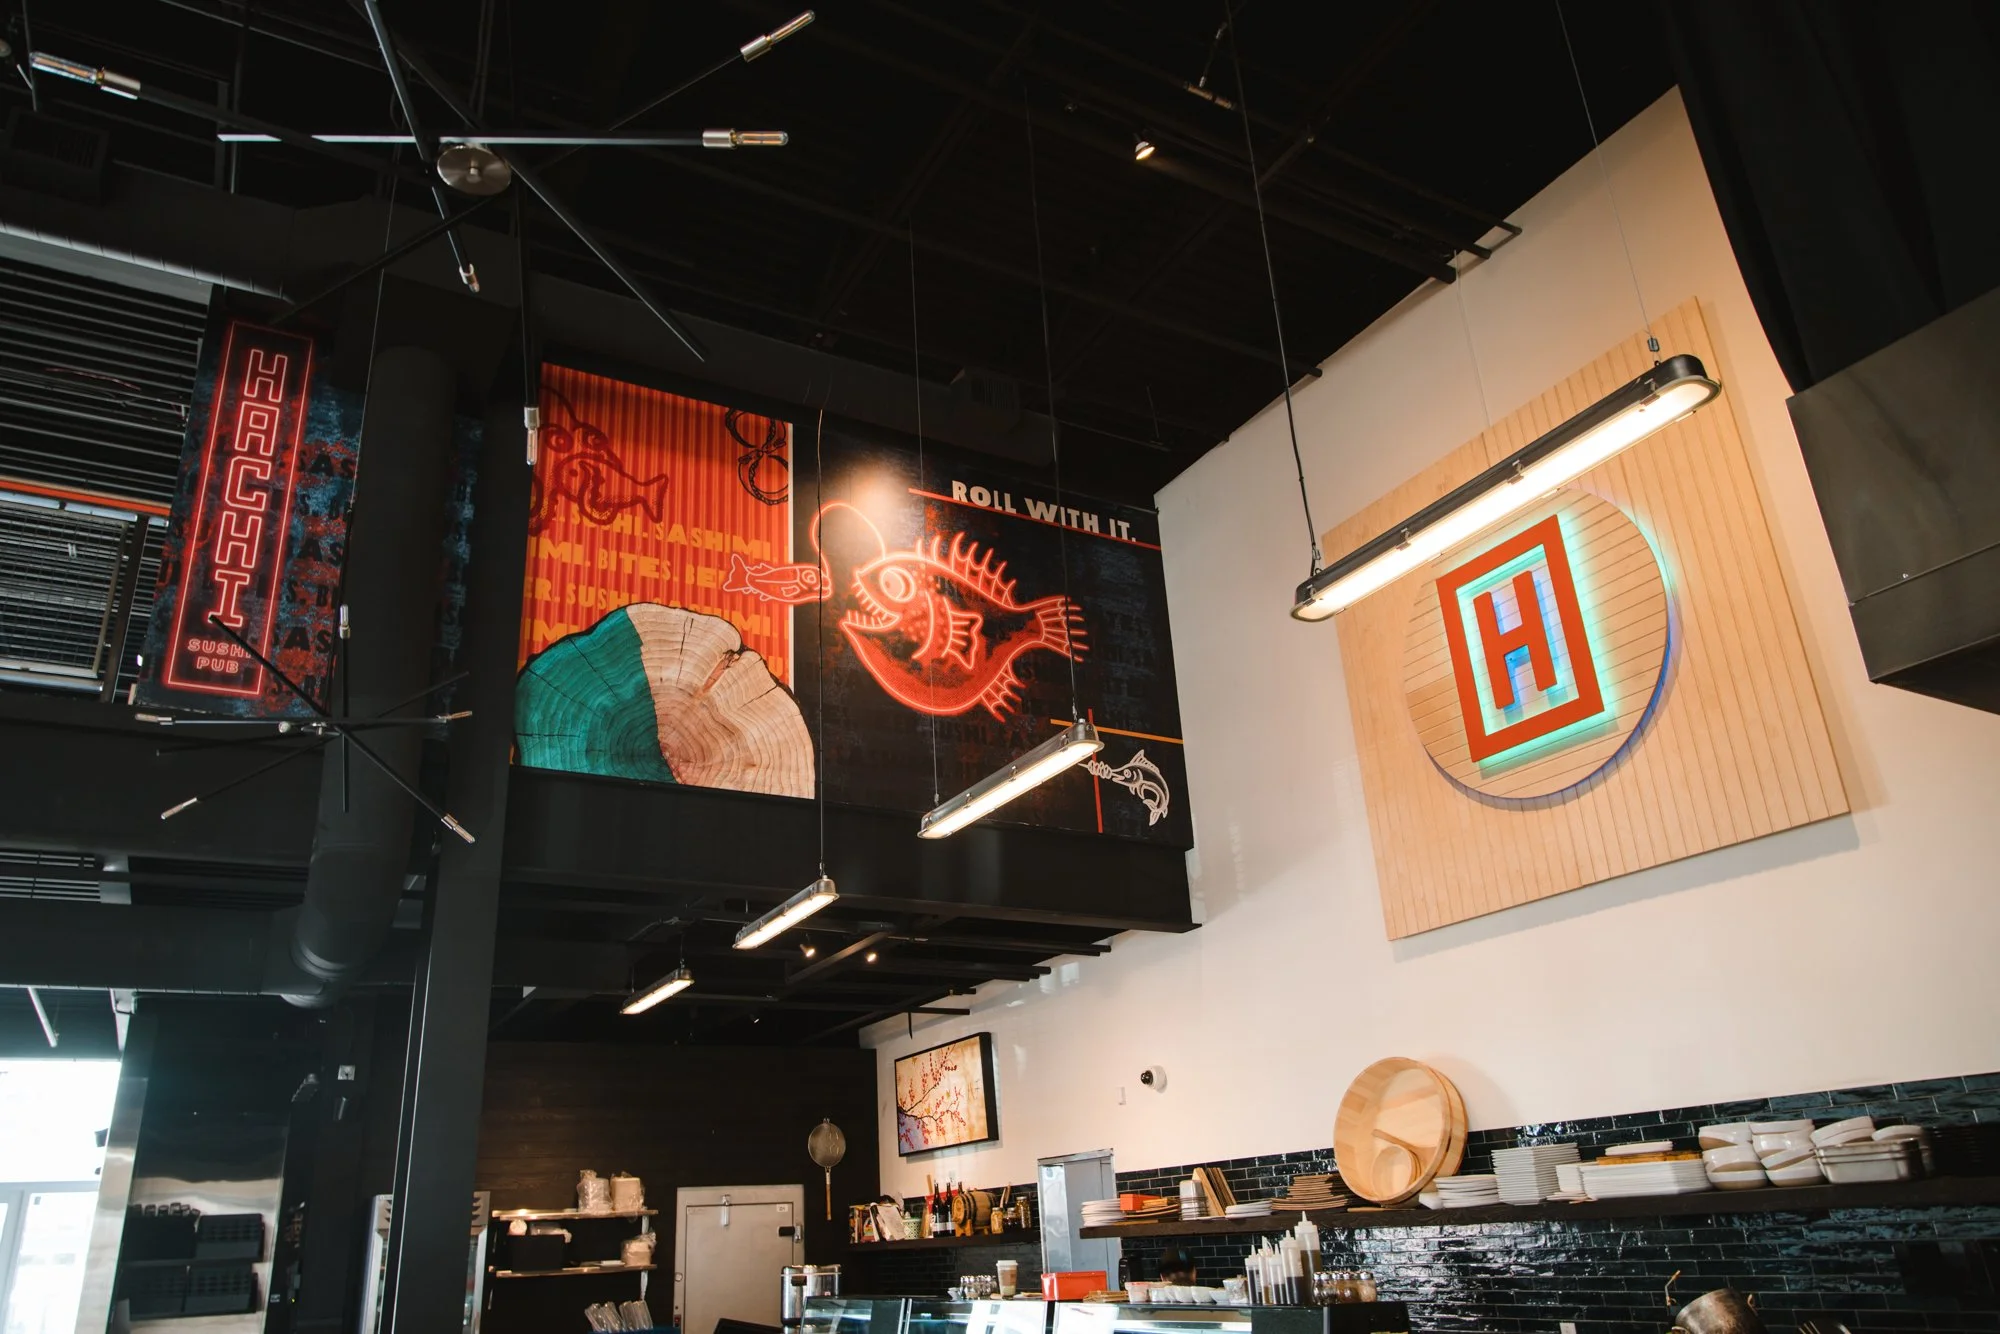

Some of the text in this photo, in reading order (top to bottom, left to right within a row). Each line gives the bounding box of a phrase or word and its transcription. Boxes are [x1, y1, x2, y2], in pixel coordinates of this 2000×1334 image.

[208, 349, 288, 628] HACHI
[952, 480, 1137, 543] ROLL WITH IT.
[187, 638, 253, 659] SUSH
[196, 656, 239, 674] PUB
[1472, 570, 1558, 710] H
